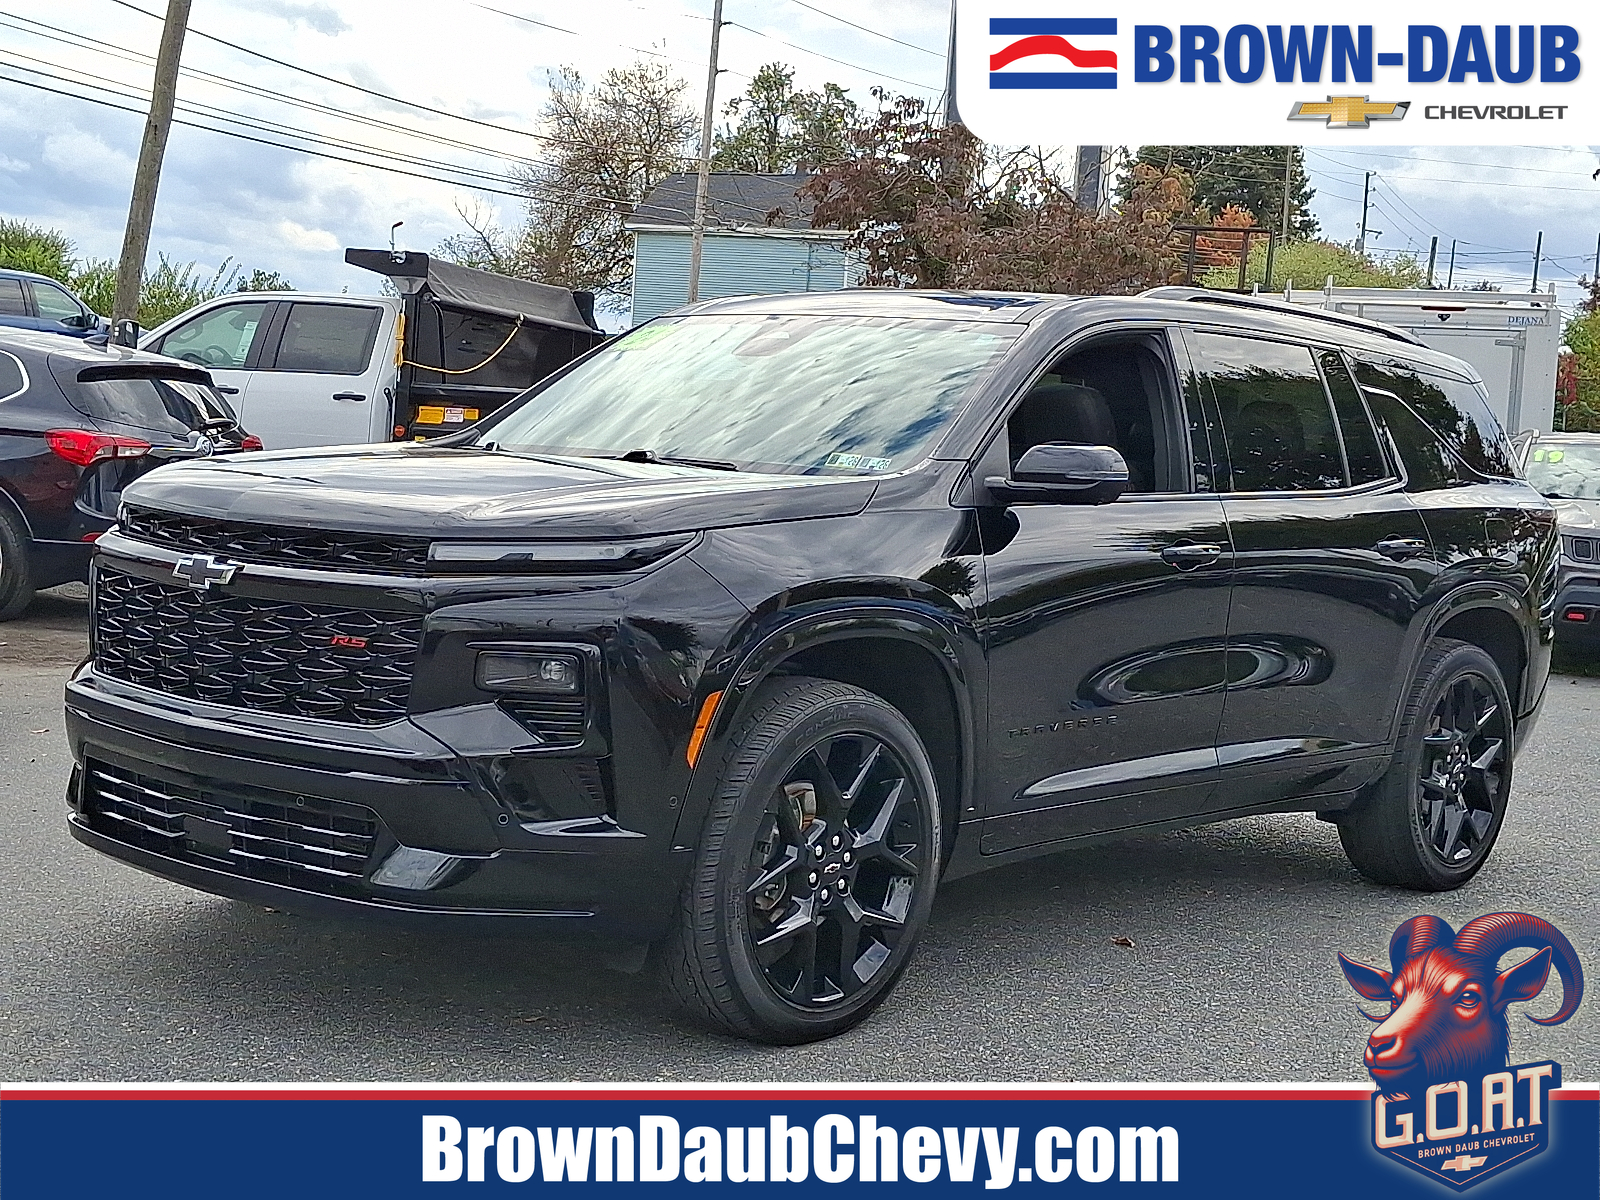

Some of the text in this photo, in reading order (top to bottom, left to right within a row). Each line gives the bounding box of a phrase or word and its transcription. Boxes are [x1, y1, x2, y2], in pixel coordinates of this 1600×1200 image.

[1533, 450, 1564, 462] 19
[331, 635, 368, 648] RS
[1007, 715, 1118, 738] TRAVERSE
